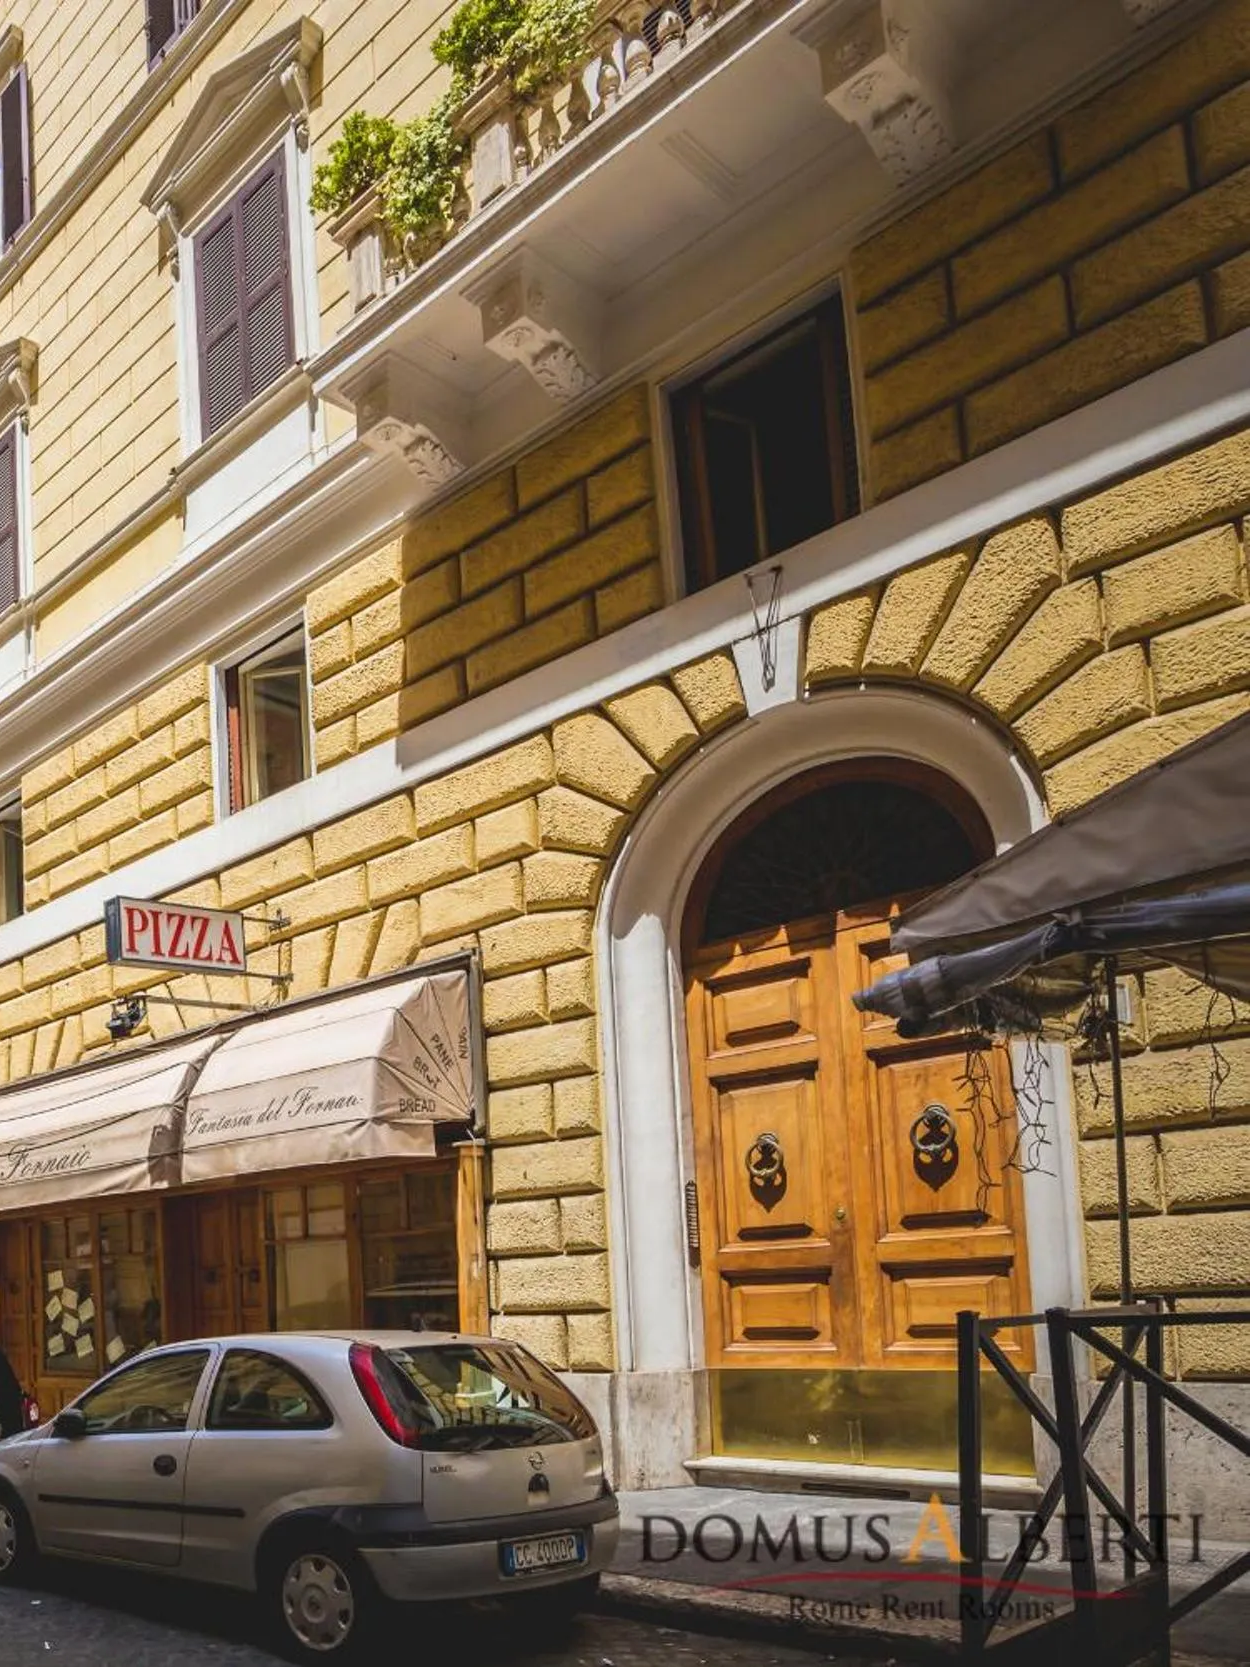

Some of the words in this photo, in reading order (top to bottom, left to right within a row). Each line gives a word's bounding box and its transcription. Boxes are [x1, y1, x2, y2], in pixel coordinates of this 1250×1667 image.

[124, 906, 241, 965] PIZZA
[431, 1033, 454, 1072] PANE
[413, 1056, 441, 1089] BRT
[256, 1094, 290, 1124] del
[399, 1098, 436, 1113] BREAD
[0, 1142, 92, 1181] Fornaio
